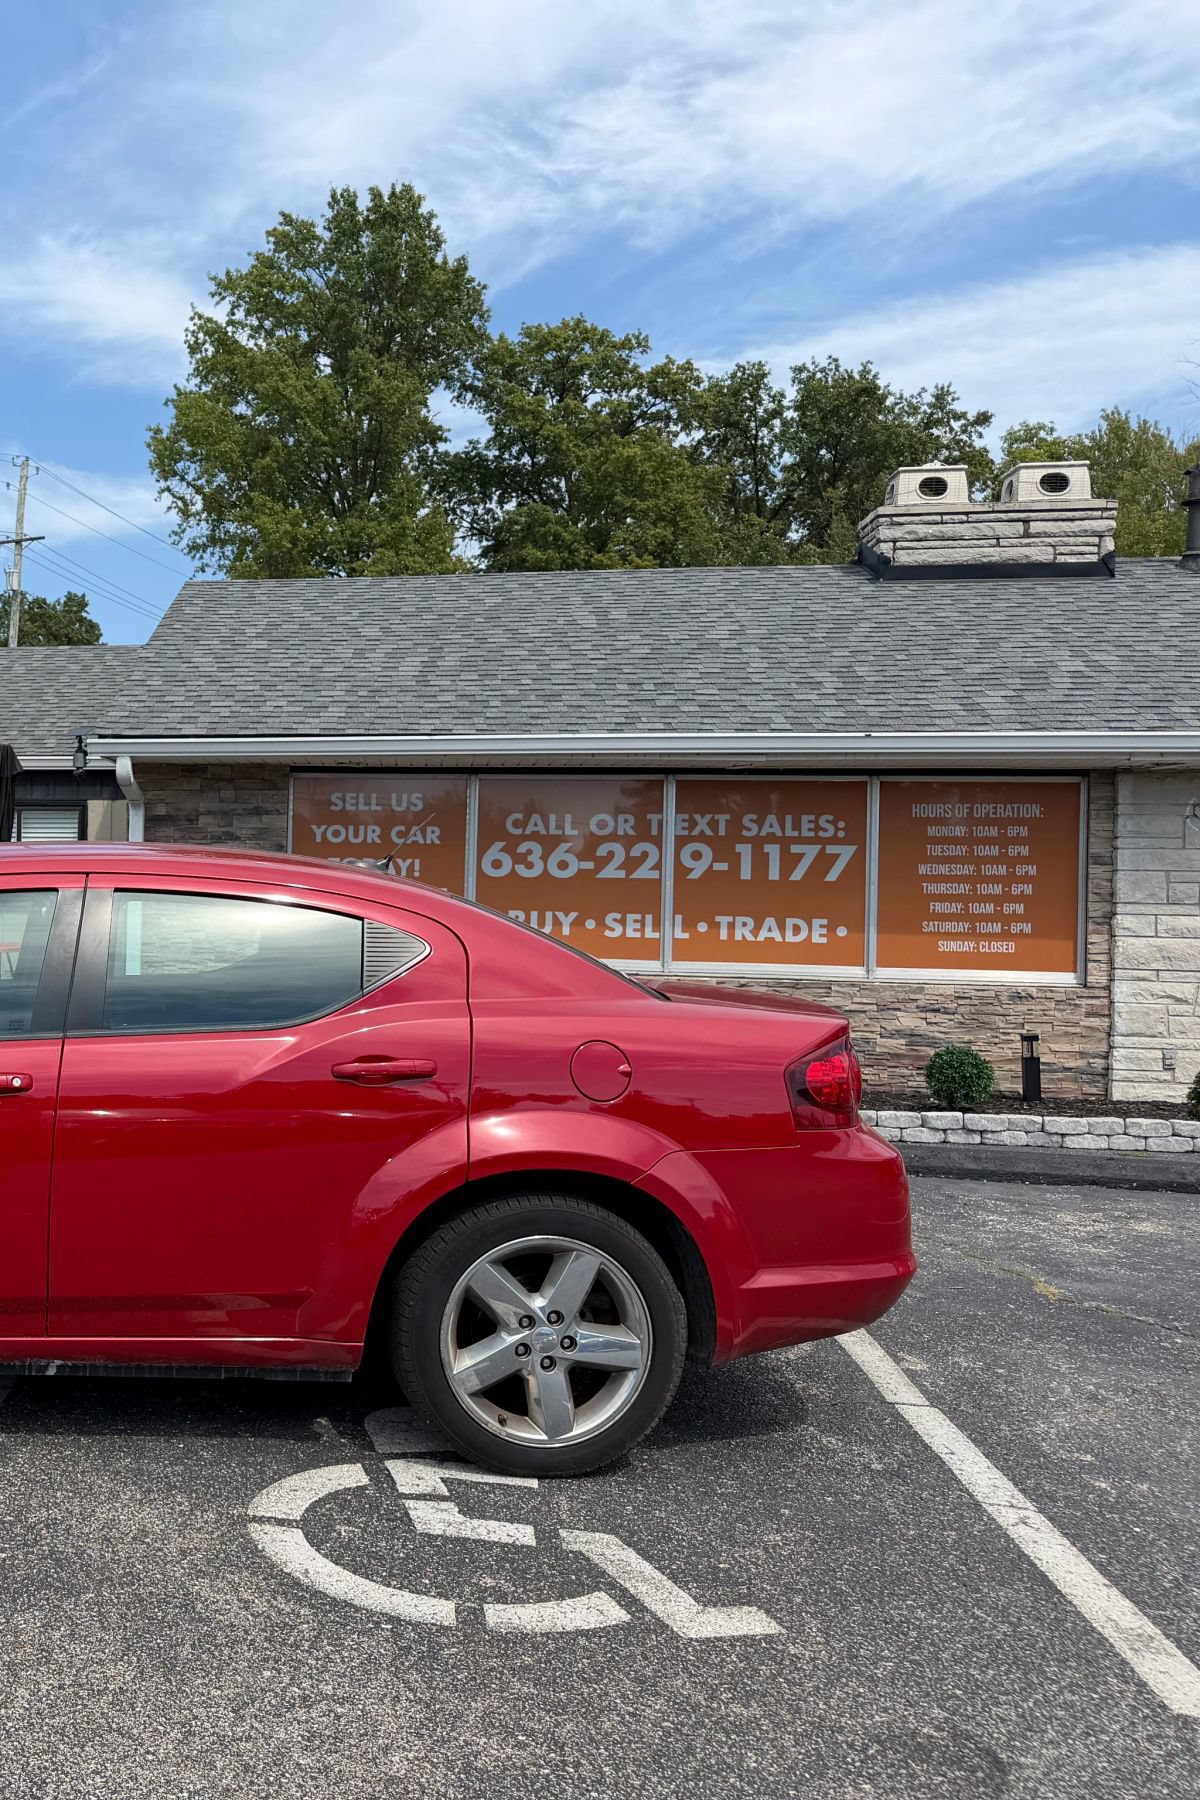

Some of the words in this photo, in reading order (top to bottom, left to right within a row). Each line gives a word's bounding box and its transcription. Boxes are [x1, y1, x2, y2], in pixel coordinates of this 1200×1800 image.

[330, 792, 382, 811] SELL
[391, 792, 423, 812] US
[912, 803, 952, 818] HOURS
[955, 804, 969, 818] OF
[973, 804, 1044, 818] OPERATION:
[505, 813, 578, 836] CALL
[588, 813, 636, 836] OR
[647, 813, 731, 836] TEXT
[741, 814, 846, 838] SALES:
[927, 826, 969, 837] MONDAY:
[972, 826, 998, 837] 10AM
[1007, 826, 1028, 837] 6PM
[311, 824, 382, 843] YOUR
[390, 825, 441, 844] CAR
[926, 845, 969, 856] TUESDAY:
[973, 845, 999, 856] 10AM
[1008, 845, 1029, 857] 6PM
[481, 841, 858, 881] 636-229-1177
[918, 864, 977, 875] WEDNESDAY:
[980, 864, 1006, 875] 10AM
[1016, 864, 1037, 876] 6PM
[922, 883, 973, 894] THURSDAY:
[976, 883, 1002, 895] 10AM
[1011, 883, 1032, 895] 6PM
[929, 903, 965, 914] FRIDAY:
[968, 903, 994, 914] 10AM
[1003, 903, 1024, 914] 6PM
[604, 912, 690, 939] SELL
[715, 915, 828, 943] TRADE
[922, 922, 972, 933] SATURDAY:
[975, 922, 1001, 933] 10AM
[1010, 922, 1032, 934] 6PM
[938, 941, 977, 952] SUNDAY:
[979, 941, 1015, 953] CLOSED
